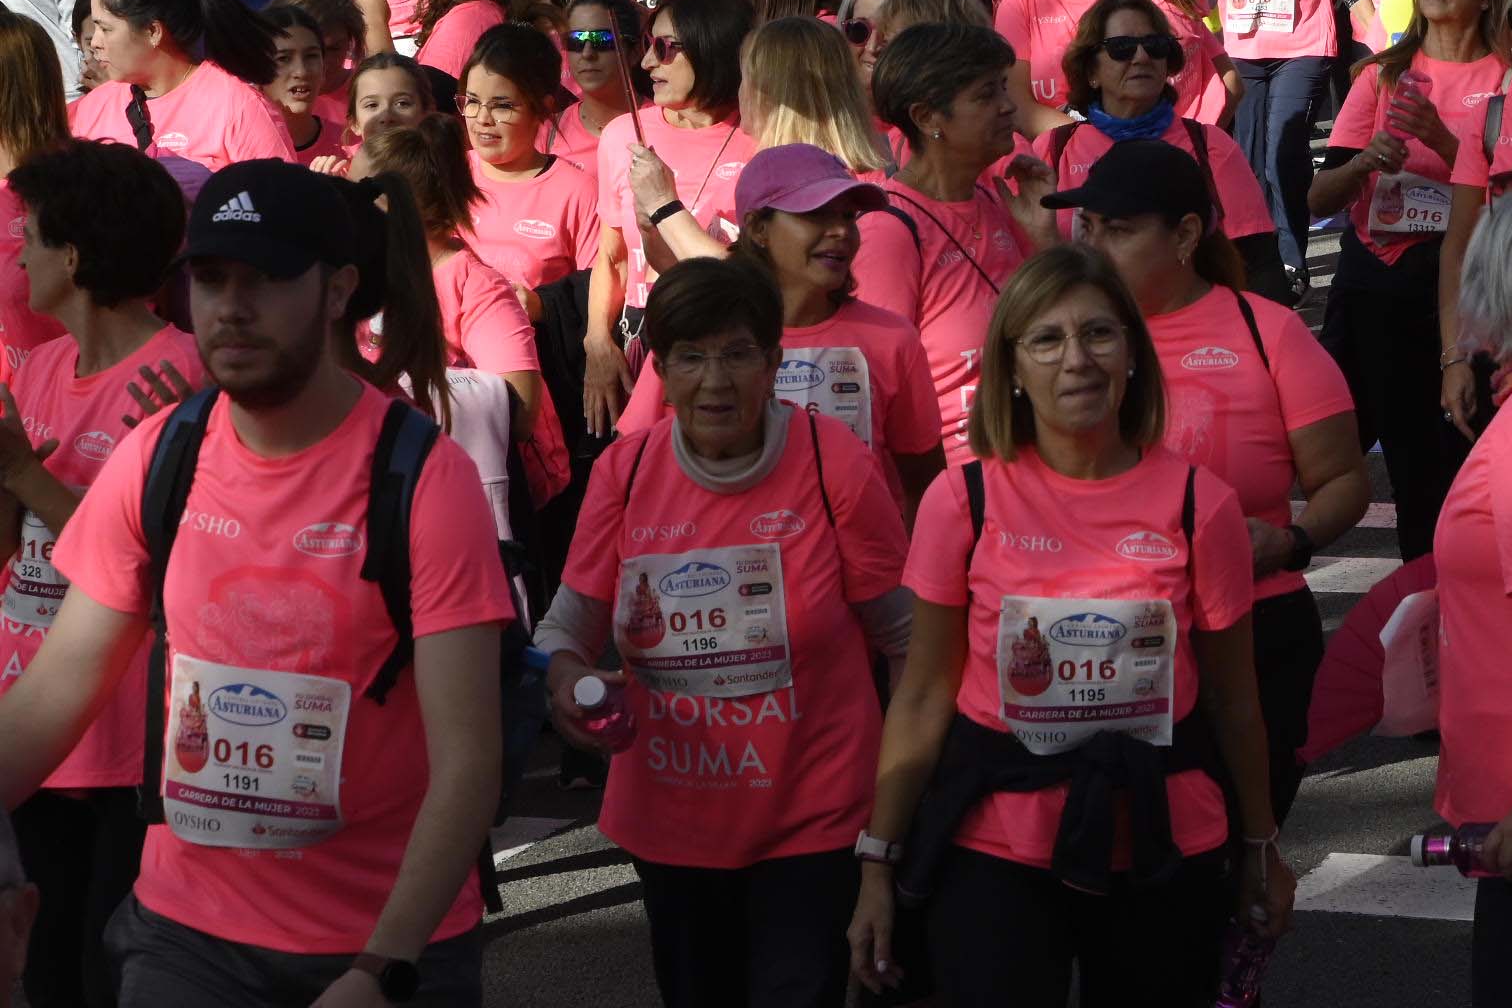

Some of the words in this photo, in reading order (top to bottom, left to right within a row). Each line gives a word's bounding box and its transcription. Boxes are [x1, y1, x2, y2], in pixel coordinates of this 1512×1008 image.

[212, 209, 261, 223] adidas
[1406, 208, 1442, 222] 016
[1184, 356, 1236, 367] ASTURIANA
[829, 366, 858, 374] SUMA
[775, 374, 821, 385] STURIANA
[21, 537, 55, 561] 16
[298, 532, 361, 551] ASTURIANA
[1120, 542, 1176, 557] ASTURIANA
[736, 564, 769, 574] SUMA
[29, 584, 39, 593] LA
[40, 586, 66, 597] MUJE
[664, 575, 726, 592] ASTURIANA
[669, 607, 728, 633] 016
[1054, 625, 1122, 640] ASTURIANA
[683, 637, 718, 652] 1196
[685, 658, 697, 667] DE
[700, 657, 712, 666] LA
[713, 654, 747, 665] MUJER
[727, 671, 778, 685] Santander
[1058, 659, 1117, 682] 016
[1069, 688, 1106, 703] 1195
[210, 695, 286, 721] ASTURIANA
[295, 699, 333, 714] SUMA
[648, 690, 804, 727] DORSAL
[1019, 709, 1066, 721] CARRERA
[1067, 709, 1083, 719] DE
[1084, 709, 1098, 718] LA
[1016, 728, 1067, 744] OYSHO
[212, 737, 276, 772] 016
[648, 735, 767, 777] SUMA
[223, 773, 260, 792] 1191
[178, 787, 220, 805] CARRERA
[221, 796, 236, 808] DE
[238, 799, 251, 810] LA
[254, 801, 292, 815] MUJER
[174, 810, 222, 834] OYSHO
